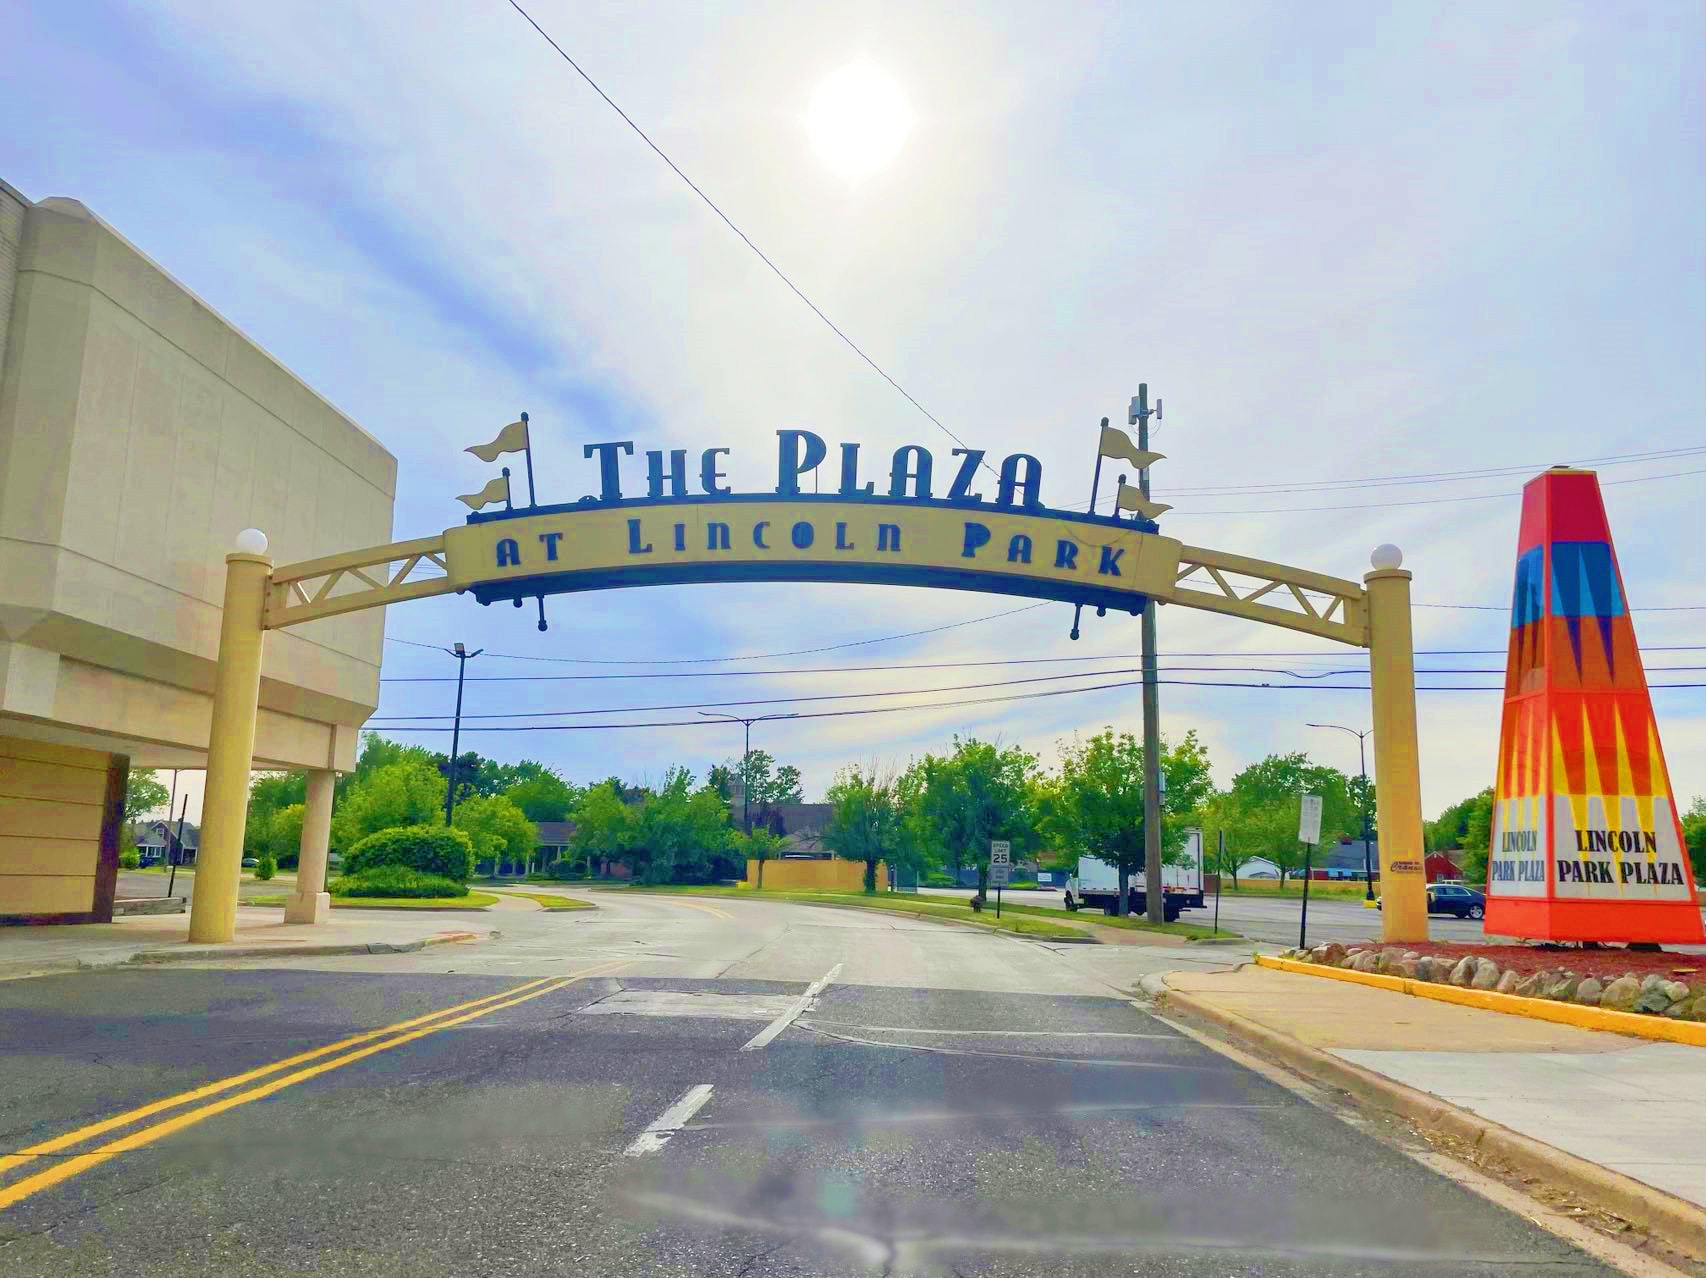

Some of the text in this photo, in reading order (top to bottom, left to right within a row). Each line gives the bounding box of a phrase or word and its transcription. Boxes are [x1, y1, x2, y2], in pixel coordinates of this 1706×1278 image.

[583, 429, 1045, 507] THE PLAZA
[496, 532, 563, 567] AT
[961, 522, 1125, 576] PARK
[1502, 830, 1537, 852] LINCOLN
[1573, 829, 1657, 853] LINCOLN
[993, 853, 1008, 864] 25
[1492, 860, 1545, 881] PARK PLAZA
[1557, 860, 1685, 885] PARK PLAZA
